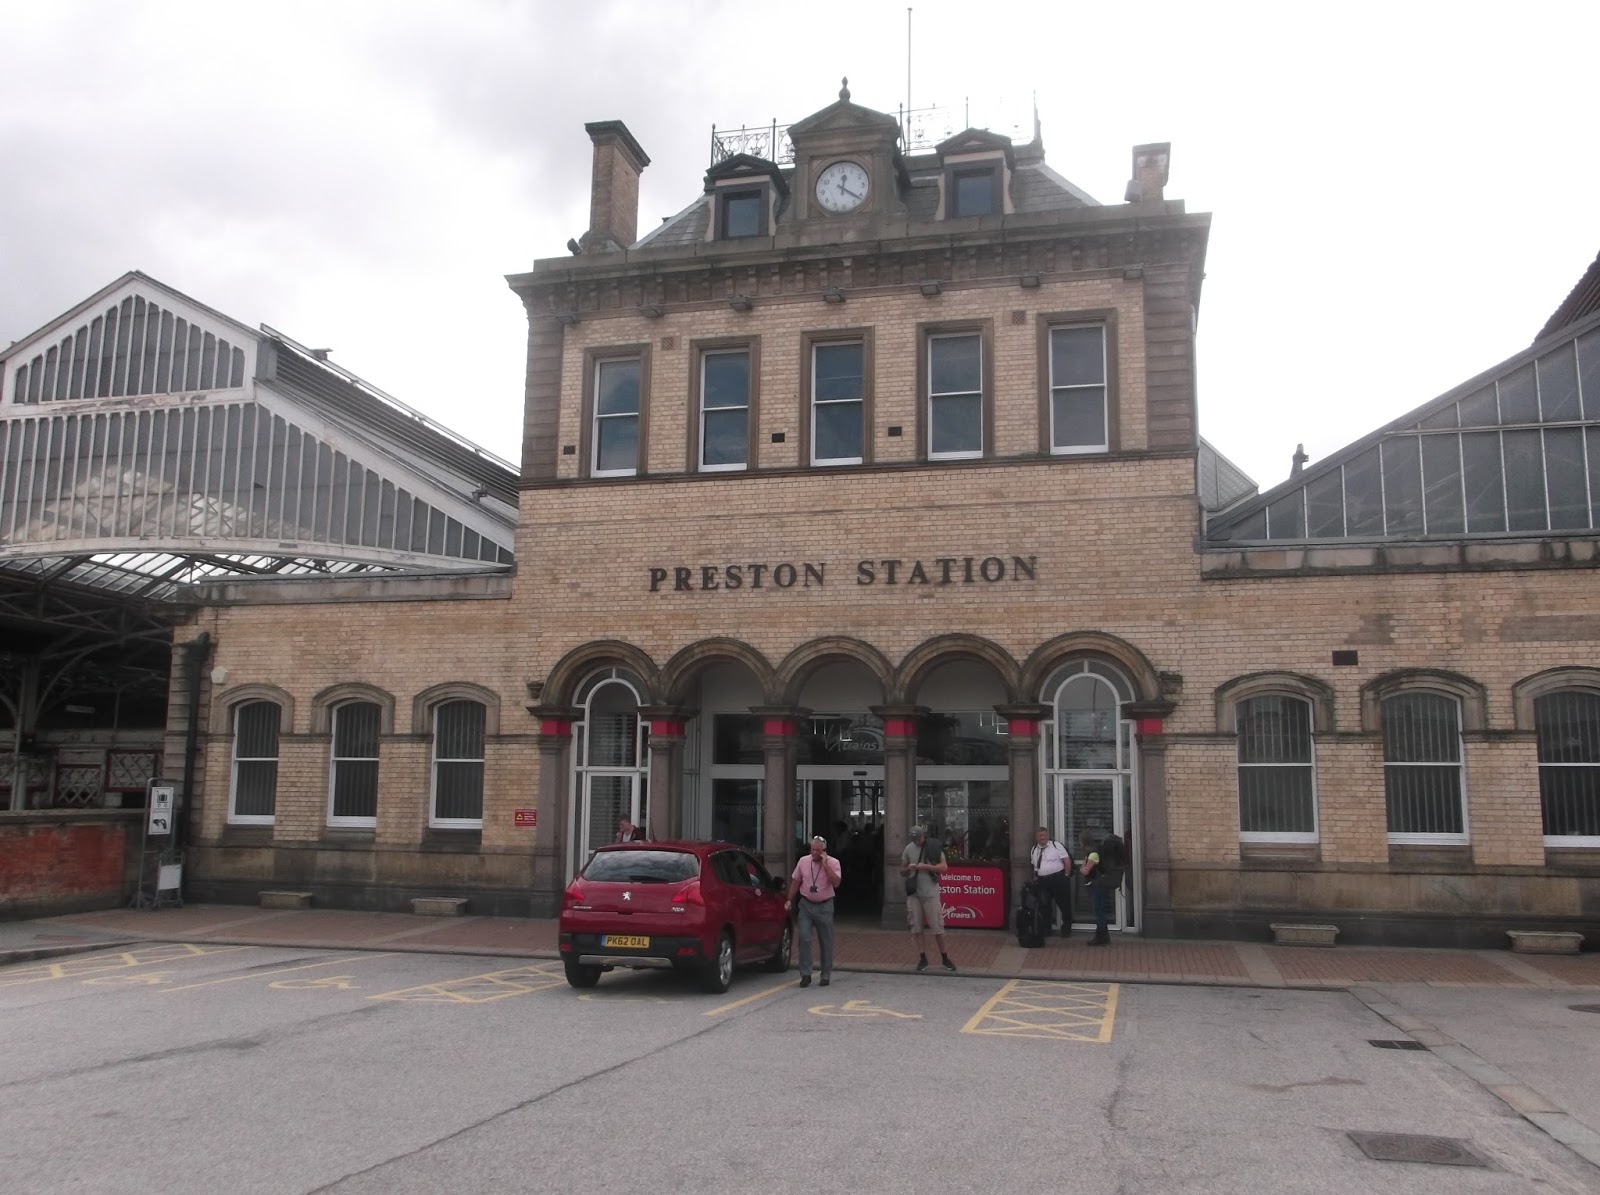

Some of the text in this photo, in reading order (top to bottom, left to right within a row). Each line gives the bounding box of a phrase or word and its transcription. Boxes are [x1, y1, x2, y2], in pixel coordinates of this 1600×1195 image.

[648, 555, 1037, 592] PRESTON STATION
[940, 873, 971, 881] Welcome
[939, 884, 995, 895] eston Station
[606, 936, 647, 947] PK62 OAL
